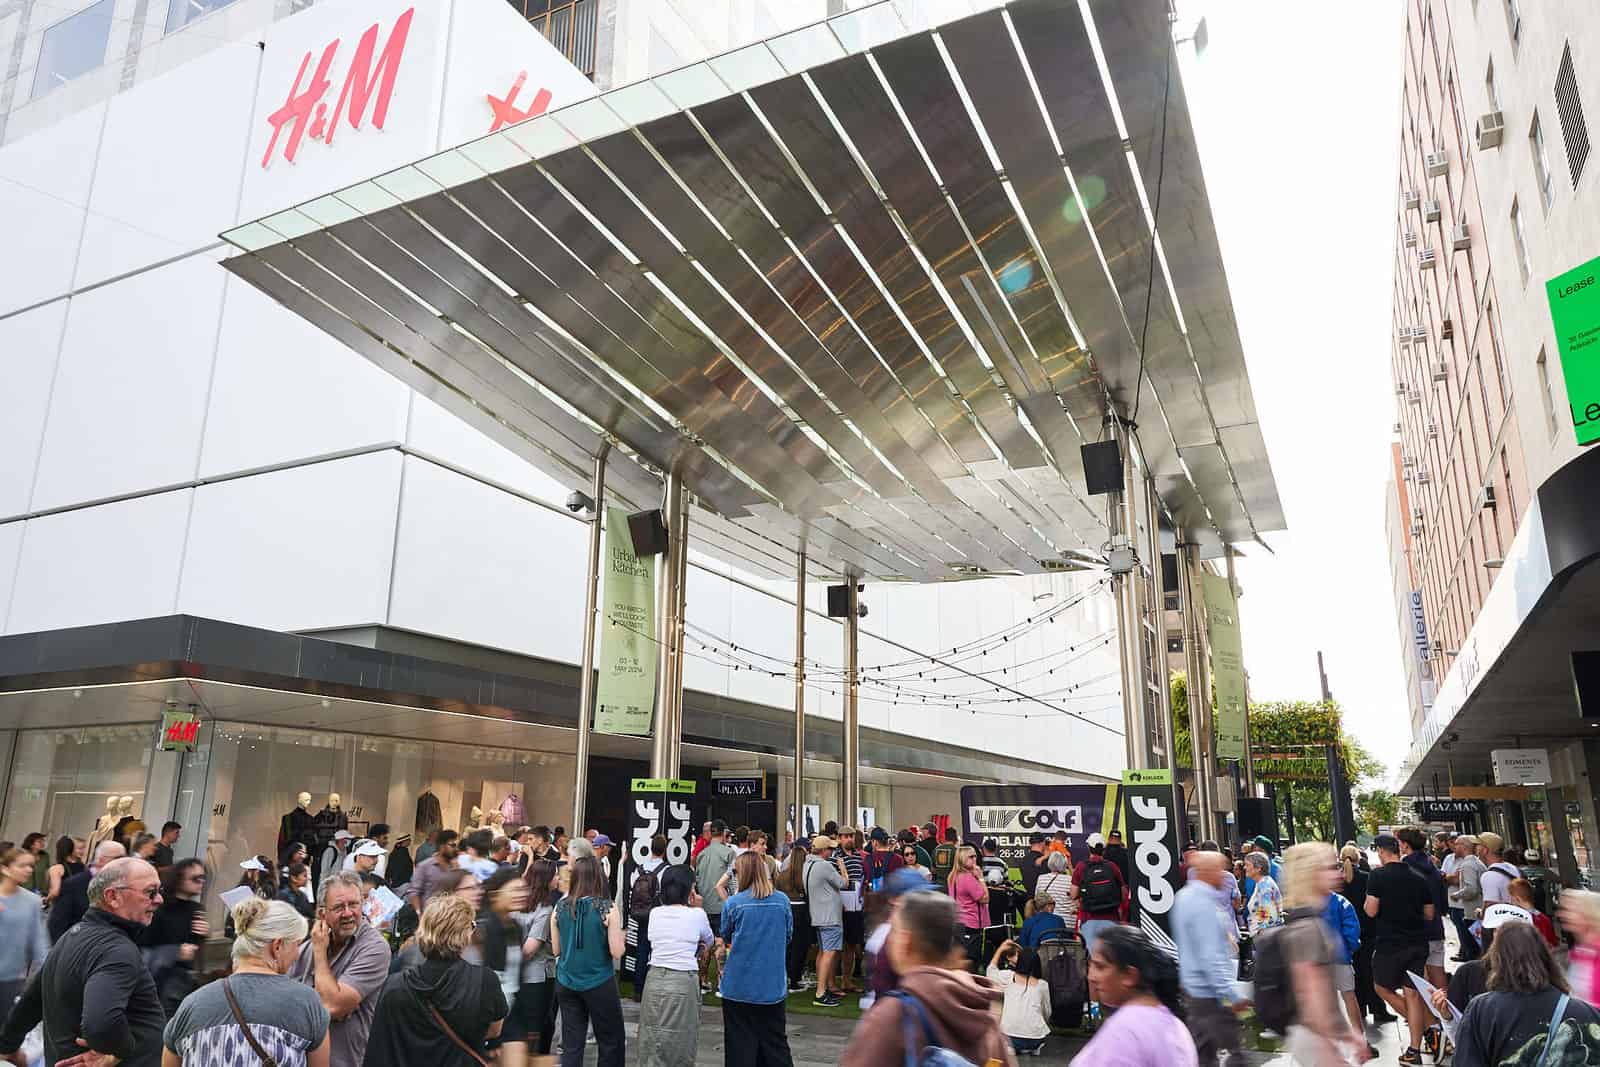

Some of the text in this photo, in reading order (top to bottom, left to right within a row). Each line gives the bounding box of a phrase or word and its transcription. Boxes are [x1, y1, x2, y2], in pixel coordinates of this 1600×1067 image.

[262, 7, 414, 168] H&M
[1558, 276, 1595, 298] Lease
[612, 560, 649, 578] Kitchen
[721, 784, 752, 795] PLAZA
[1018, 809, 1077, 829] GOLF
[632, 799, 660, 866] OLF
[666, 800, 691, 866] OLF
[999, 848, 1026, 858] 26-28
[1130, 795, 1175, 915] GOLF
